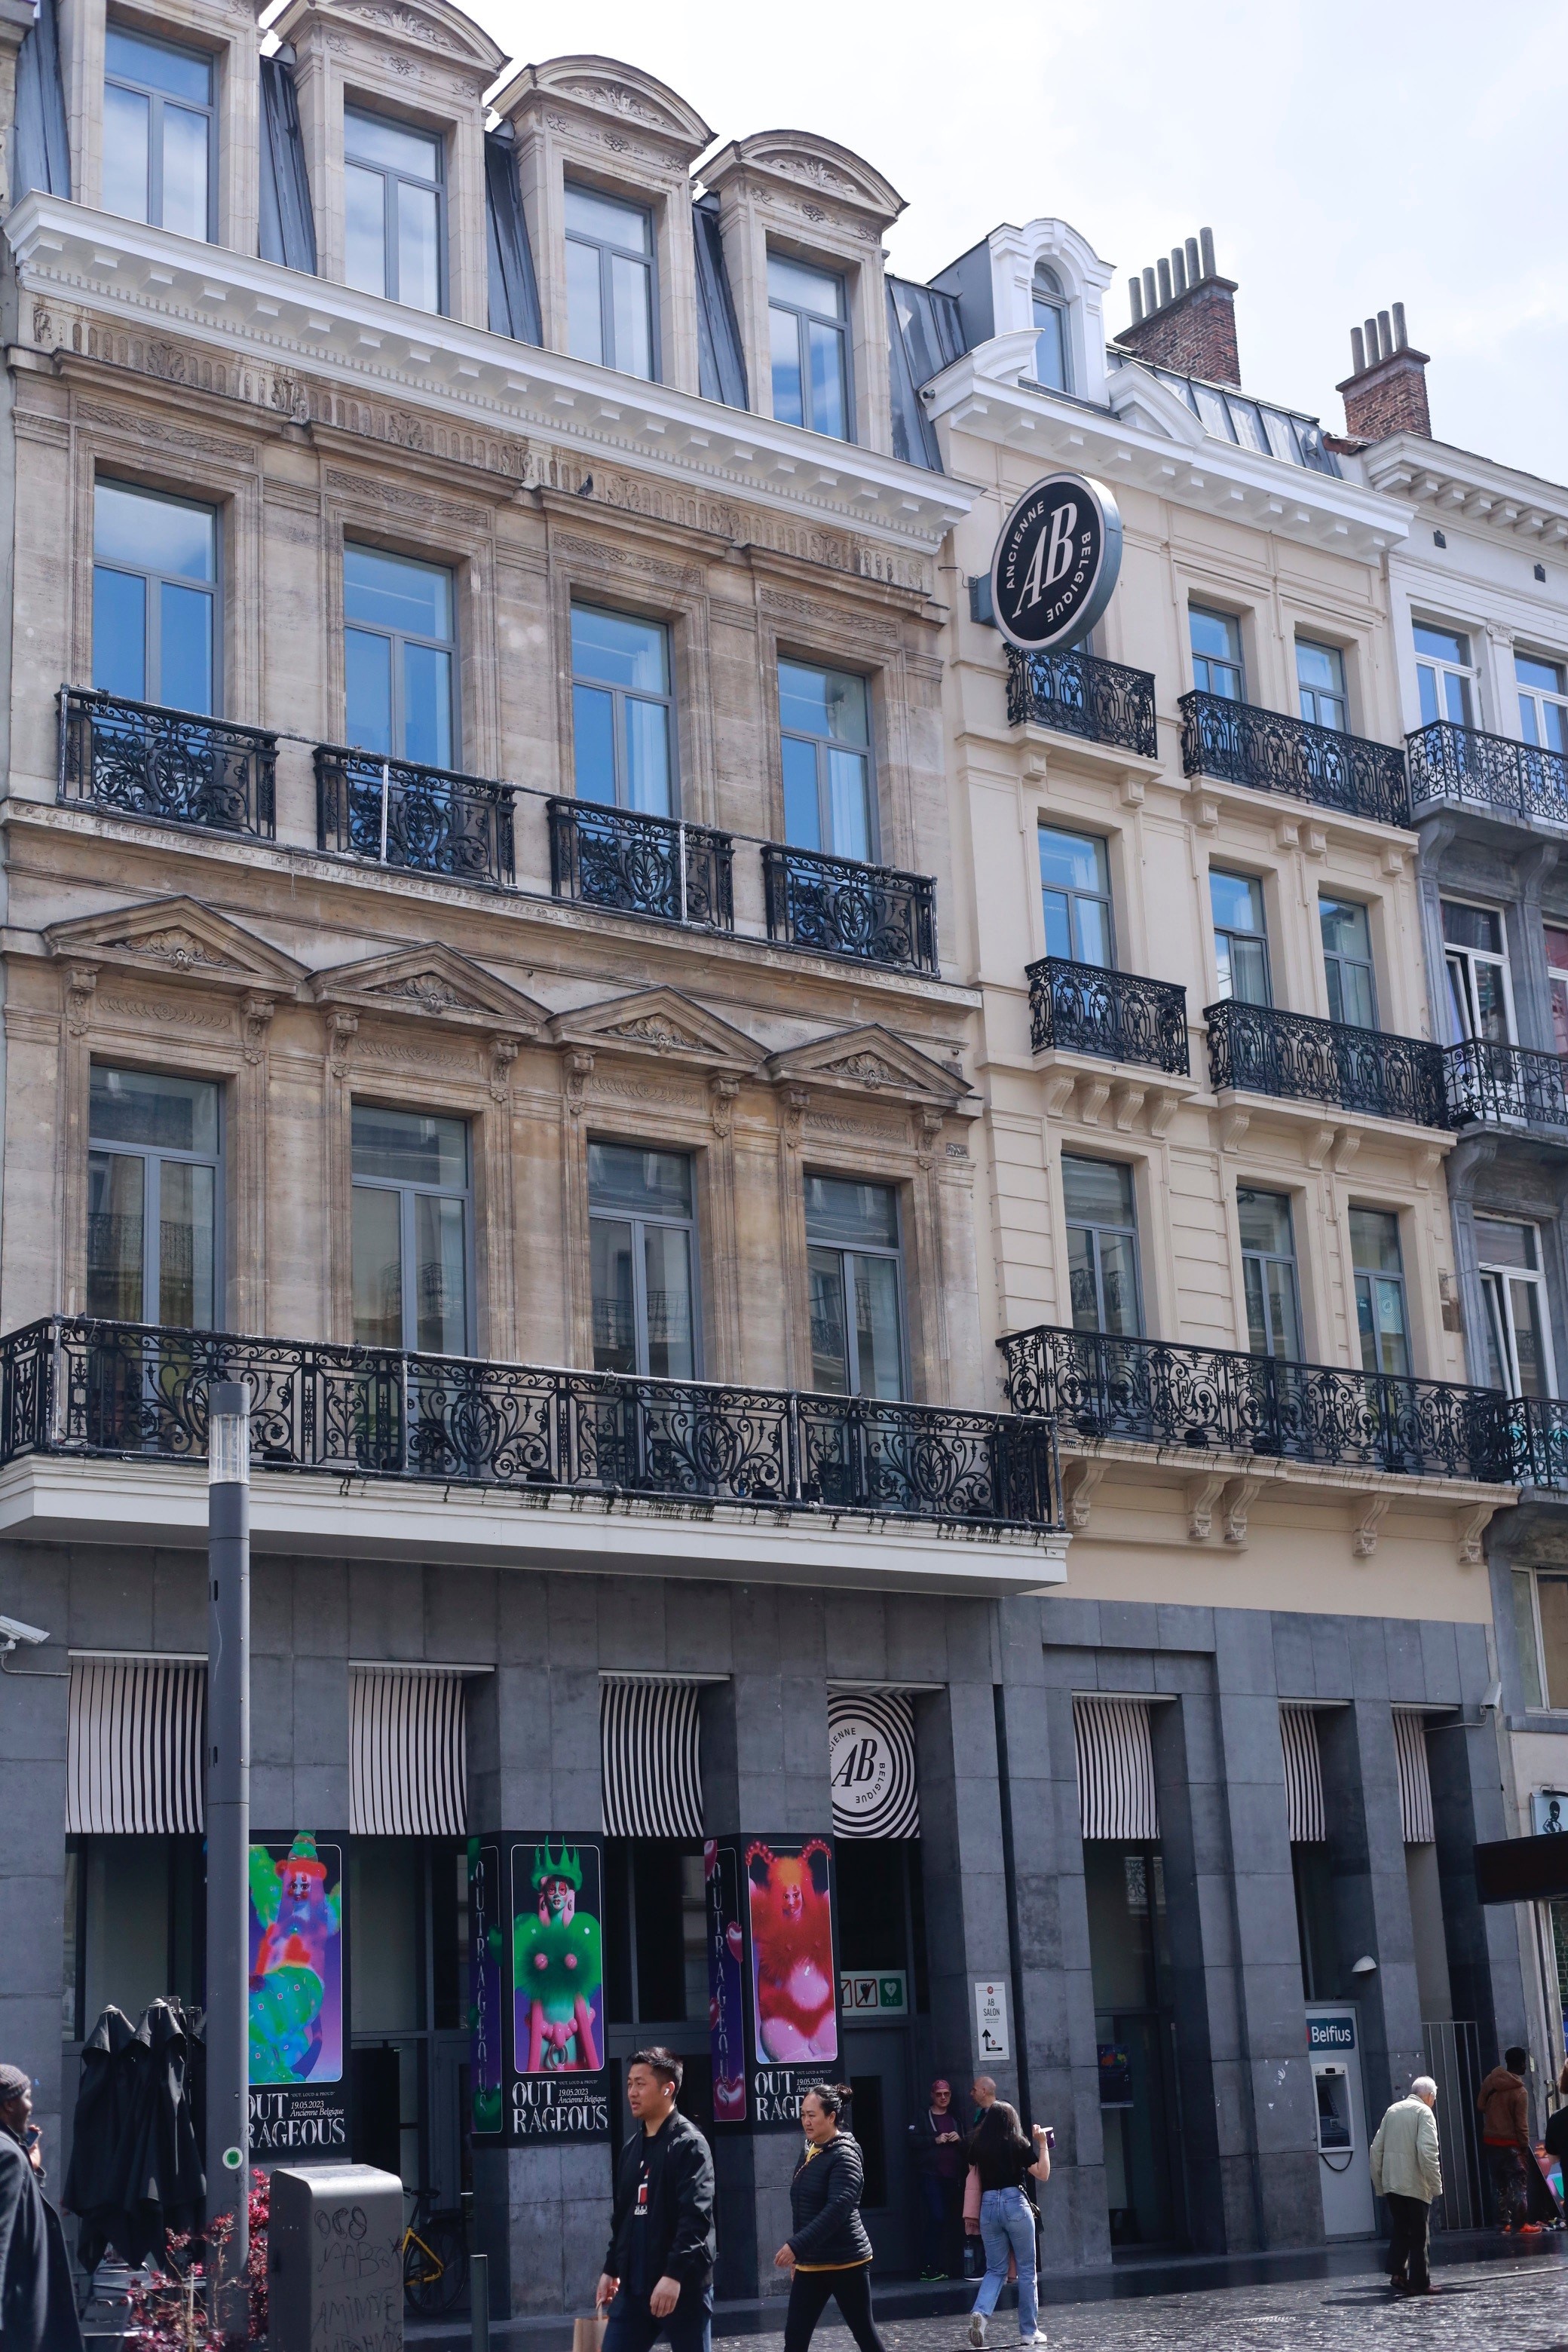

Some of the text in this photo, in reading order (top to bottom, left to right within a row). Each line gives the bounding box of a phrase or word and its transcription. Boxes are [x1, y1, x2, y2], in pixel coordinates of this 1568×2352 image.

[1006, 501, 1045, 590] ANCIENNE
[1011, 502, 1078, 619] AB
[1046, 531, 1091, 623] BELGIQUE
[831, 1738, 877, 1787] AB
[855, 1762, 886, 1804] BELGIQUE
[475, 1860, 488, 2112] OUTRAGEOUS
[983, 2008, 1000, 2017] SALON
[987, 1998, 995, 2007] AB
[1311, 2025, 1352, 2043] Belfius
[513, 2081, 556, 2106] OUT
[559, 2088, 588, 2096] 19.05.2023
[755, 2071, 795, 2095] OUT
[797, 2078, 824, 2086] 19.05.2023
[291, 2100, 324, 2110] 19.05.2023
[558, 2095, 607, 2104] Ancienne Belgique
[755, 2096, 804, 2121] RAGE
[290, 2108, 345, 2118] Ancienne Belgique
[513, 2105, 608, 2133] RAGEOUS
